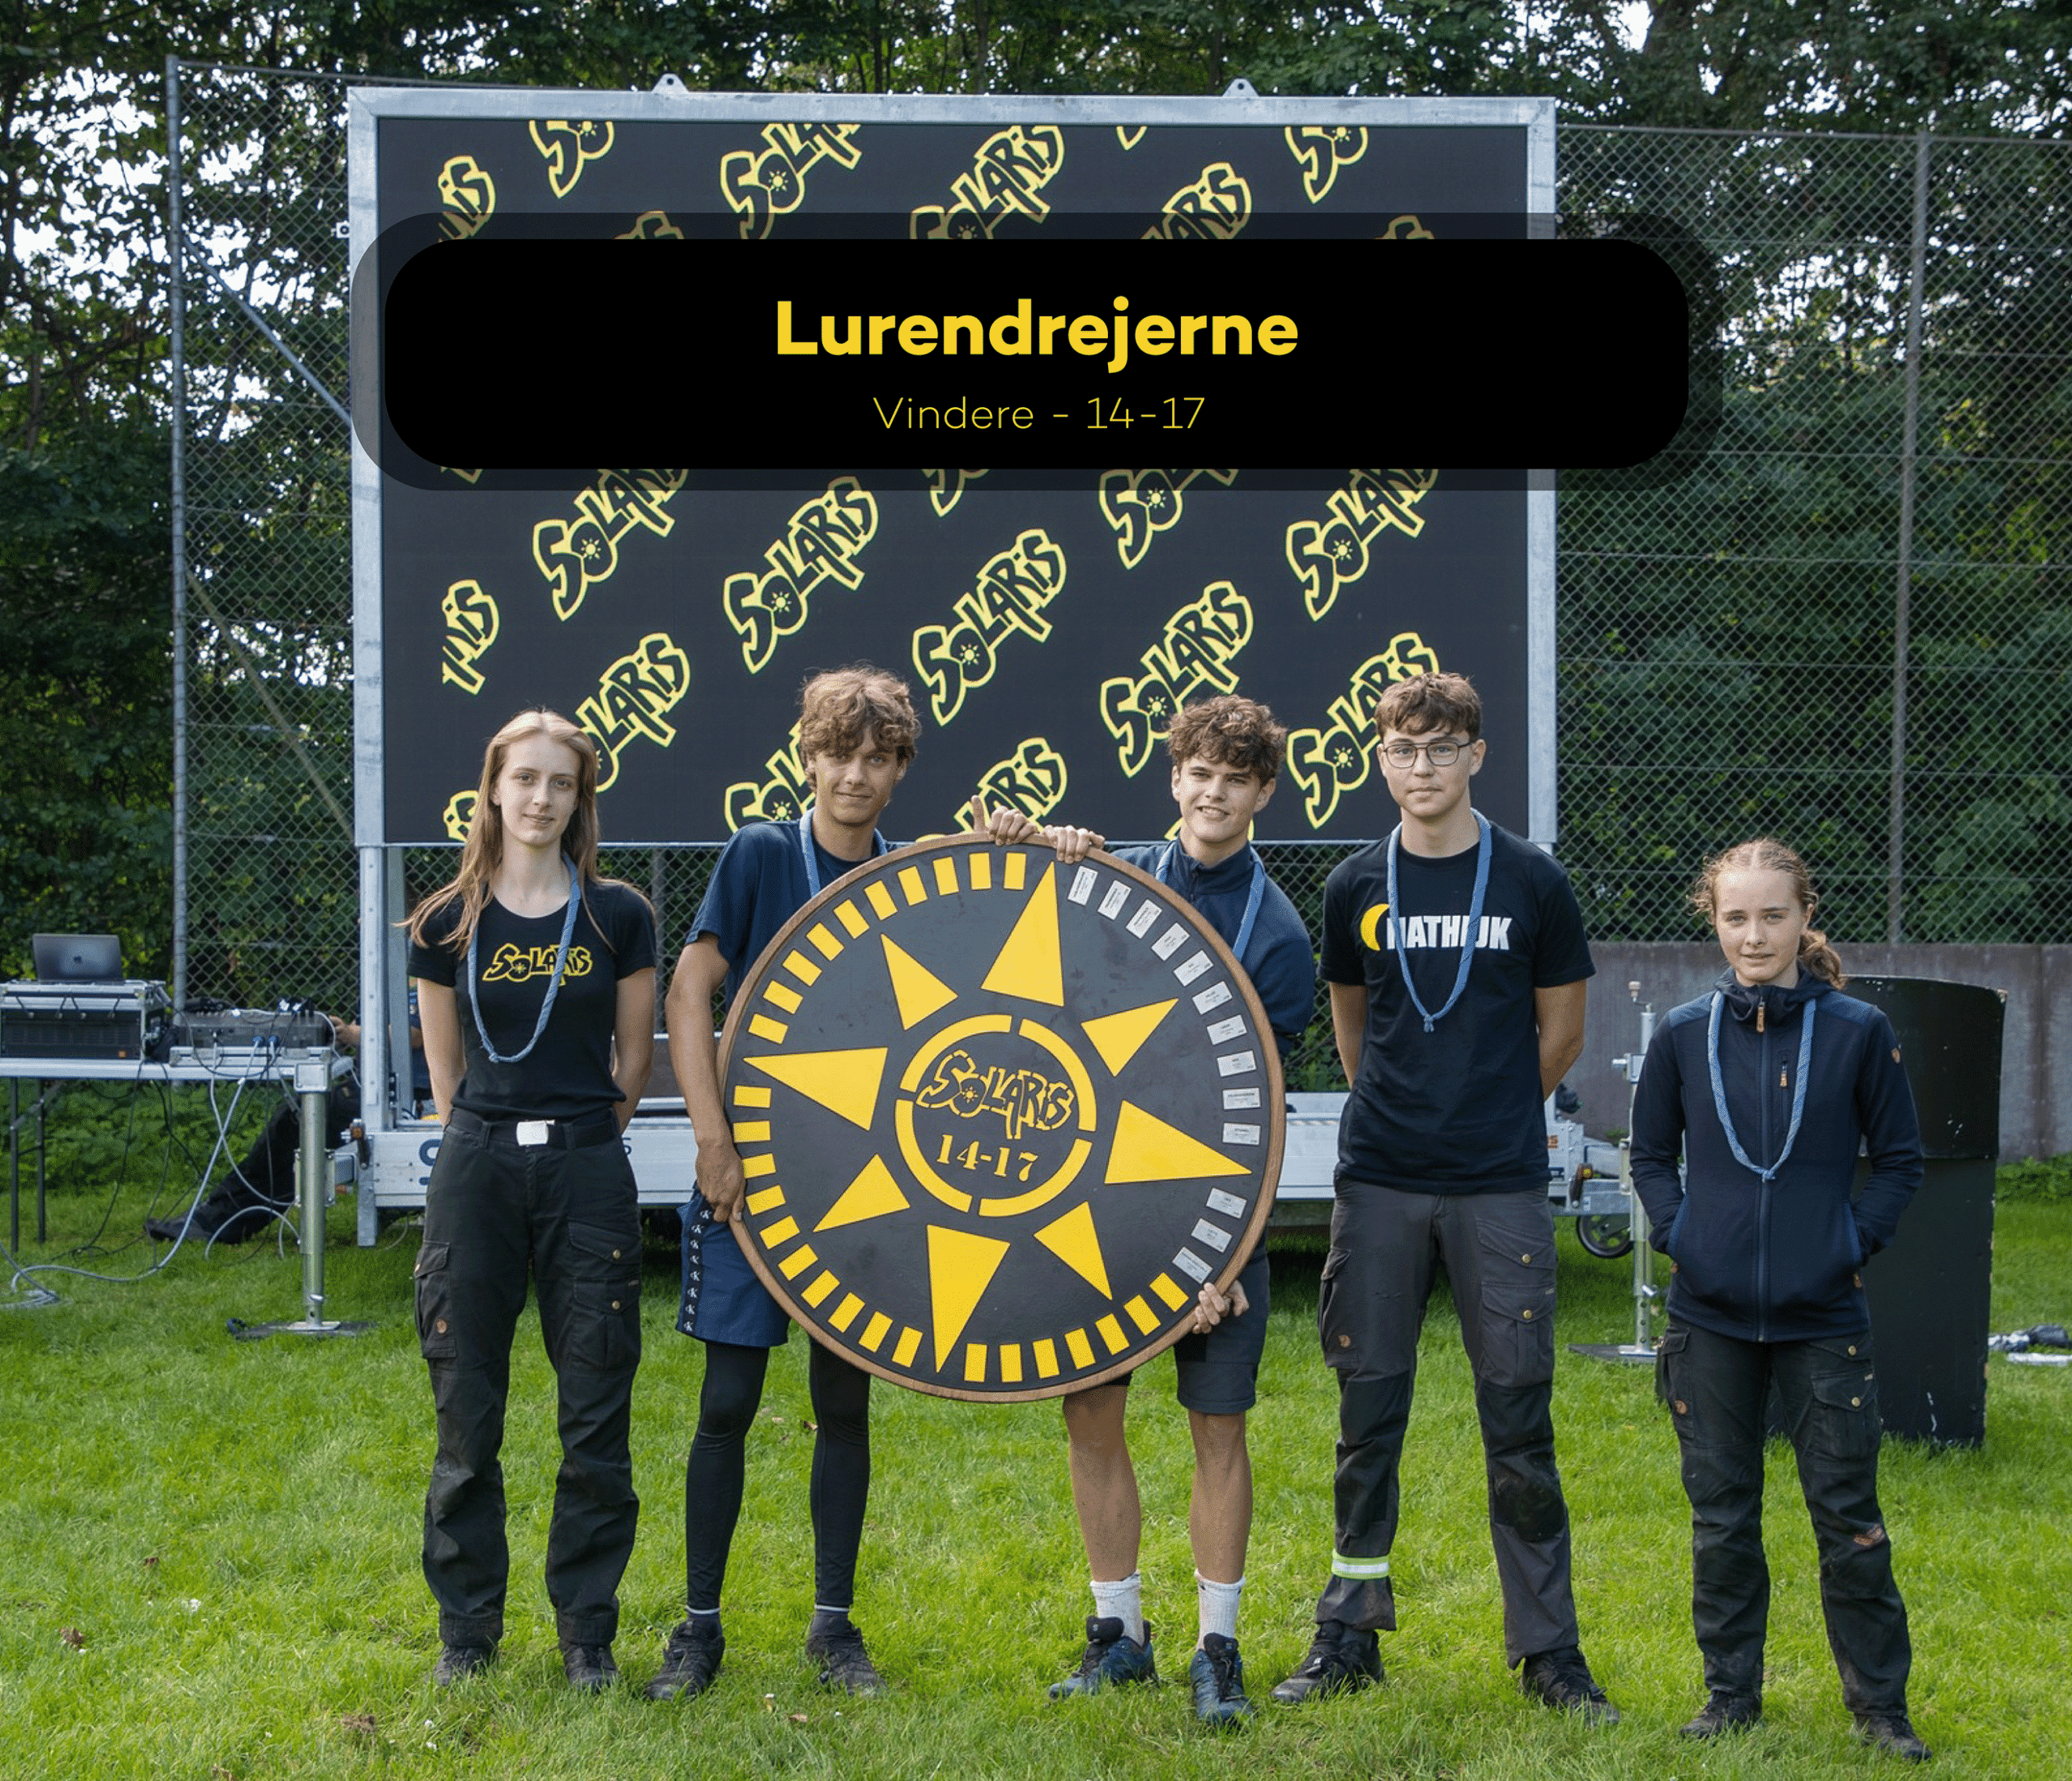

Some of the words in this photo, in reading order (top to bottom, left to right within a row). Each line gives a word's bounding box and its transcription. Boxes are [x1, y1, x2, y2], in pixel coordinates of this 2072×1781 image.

[723, 476, 879, 674] SOLARIS
[911, 528, 1068, 726] SOLARIS
[915, 1050, 1075, 1140] SOLARIS
[936, 1134, 1039, 1182] 14-17
